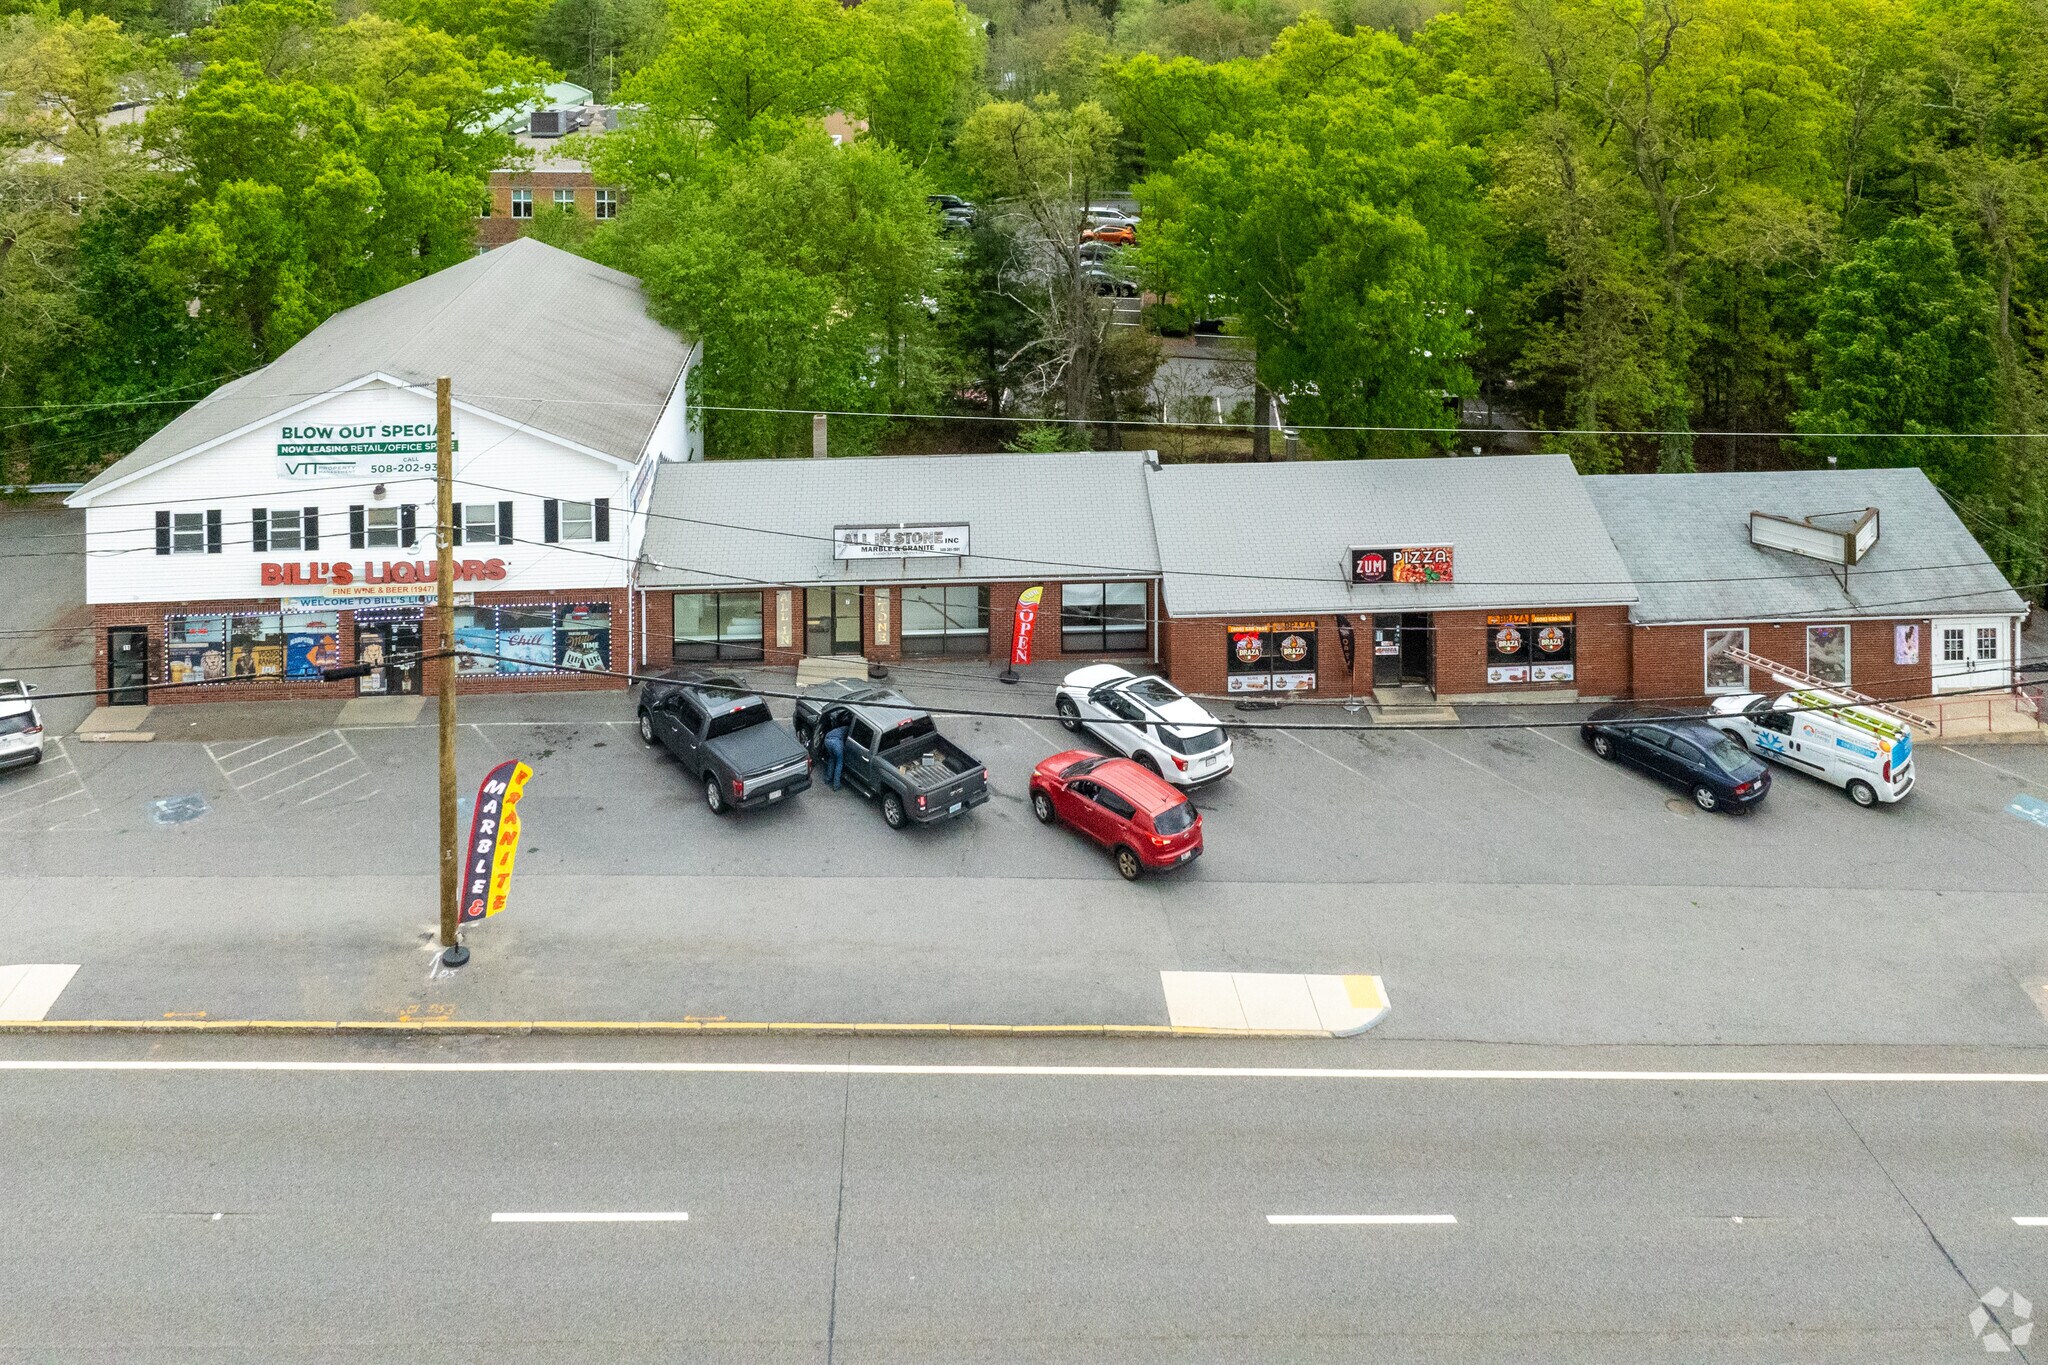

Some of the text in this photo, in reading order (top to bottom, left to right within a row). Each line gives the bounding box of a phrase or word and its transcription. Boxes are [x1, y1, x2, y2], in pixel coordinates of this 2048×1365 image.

[282, 424, 455, 439] BLOW OUT SPECI
[307, 445, 348, 453] LEASING
[350, 442, 422, 452] RETAIL/OFFICE
[424, 441, 455, 450] SPE
[371, 463, 438, 474] 508-202-93
[874, 532, 890, 546] IN
[894, 531, 944, 545] STONE
[1394, 550, 1446, 564] PIZZA
[1356, 560, 1386, 573] ZUMI
[261, 562, 353, 586] BILL'S
[300, 598, 354, 606] WELCOME
[374, 596, 406, 604] BILL'S
[507, 634, 544, 646] Chill
[1016, 609, 1034, 662] OPEN
[468, 779, 506, 916] MARBLE &
